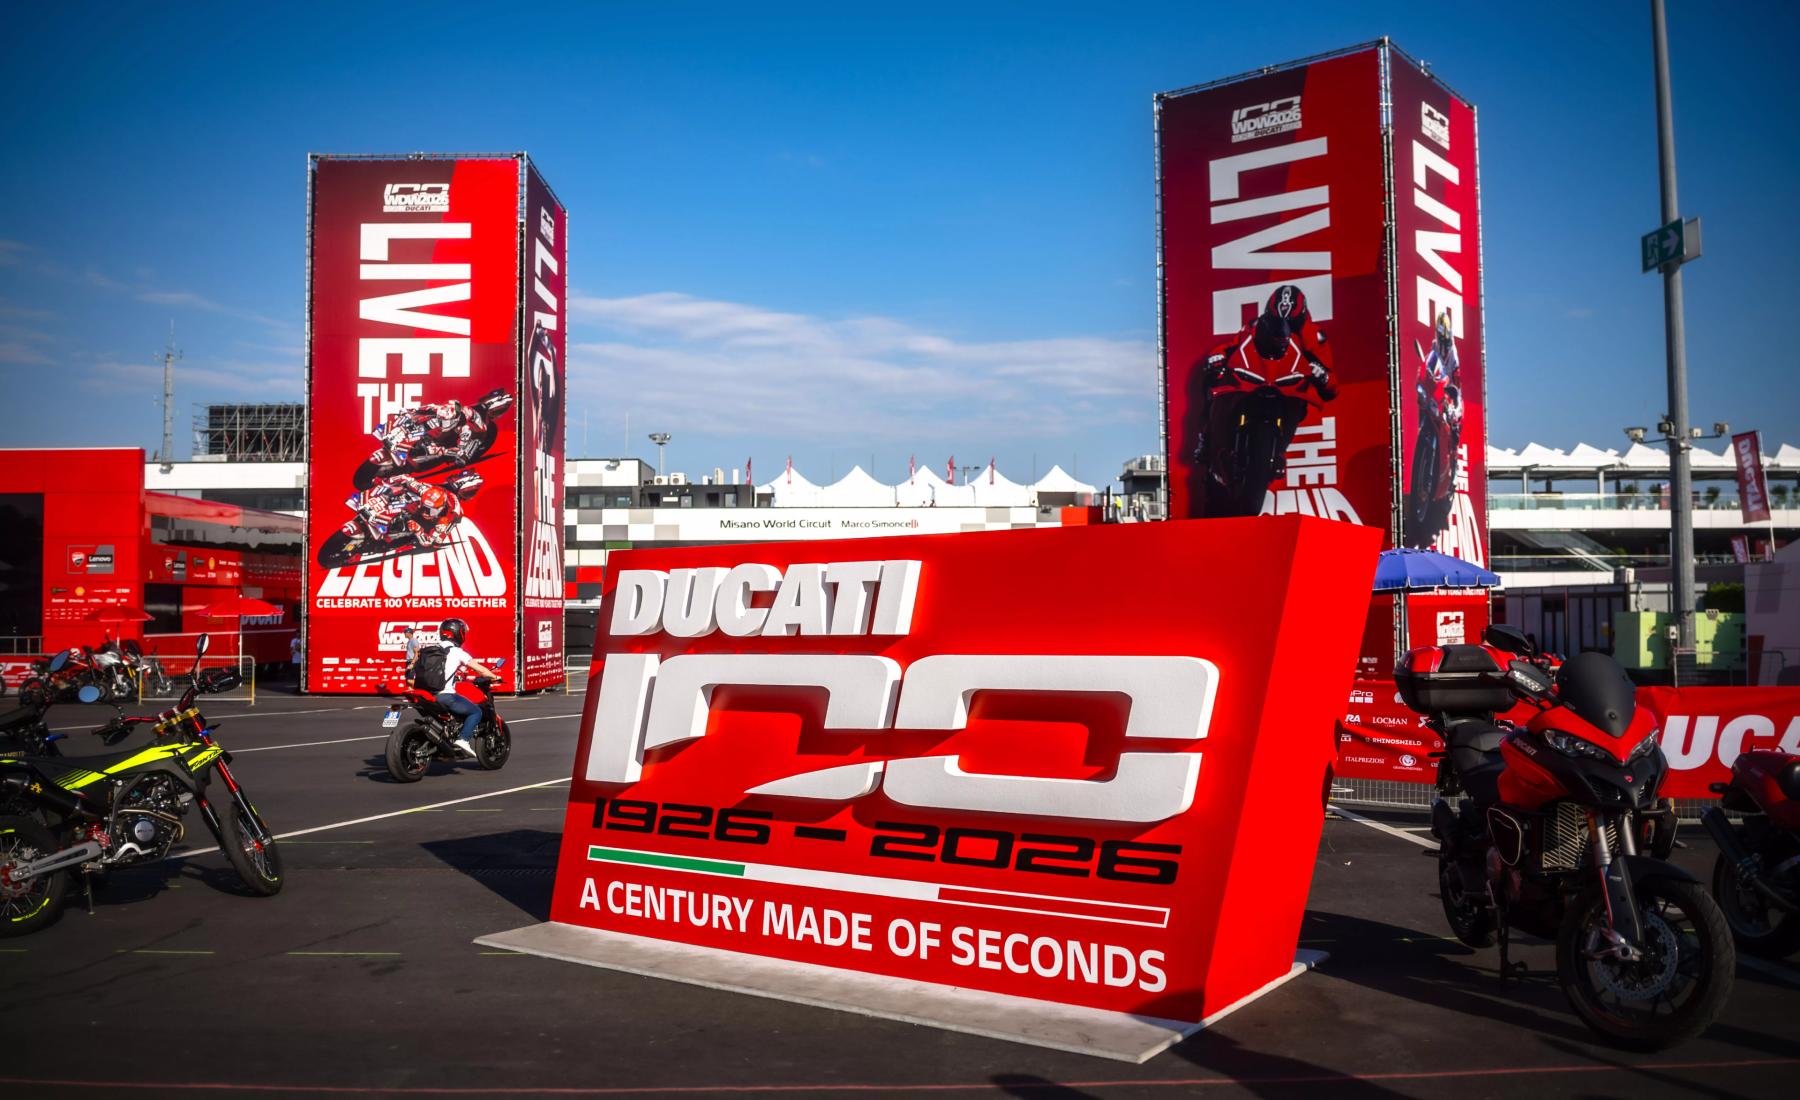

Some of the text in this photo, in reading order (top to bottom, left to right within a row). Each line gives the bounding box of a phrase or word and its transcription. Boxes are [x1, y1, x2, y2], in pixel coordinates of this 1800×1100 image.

[1232, 108, 1302, 134] WDW2026
[1209, 136, 1333, 335] LIVE
[1412, 140, 1464, 339] LIVE
[359, 222, 471, 377] LIVE
[1286, 416, 1337, 487] THE
[88, 555, 111, 563] Lenovo
[720, 519, 919, 529] Misano World Circuit Marco Simoncelli
[316, 598, 507, 608] CELEBRATE 100 YEARS TOGETHER
[610, 560, 922, 638] DUCATI
[585, 653, 1219, 823] 100
[1372, 717, 1408, 725] LOCMAN
[1372, 737, 1422, 746] RHINOSHIELD
[1344, 756, 1385, 764] ITALPREZIOSI
[592, 797, 774, 845] 1926
[869, 821, 1183, 885] 2026
[579, 878, 1167, 993] A CENTURY MADE OF SECONDS
